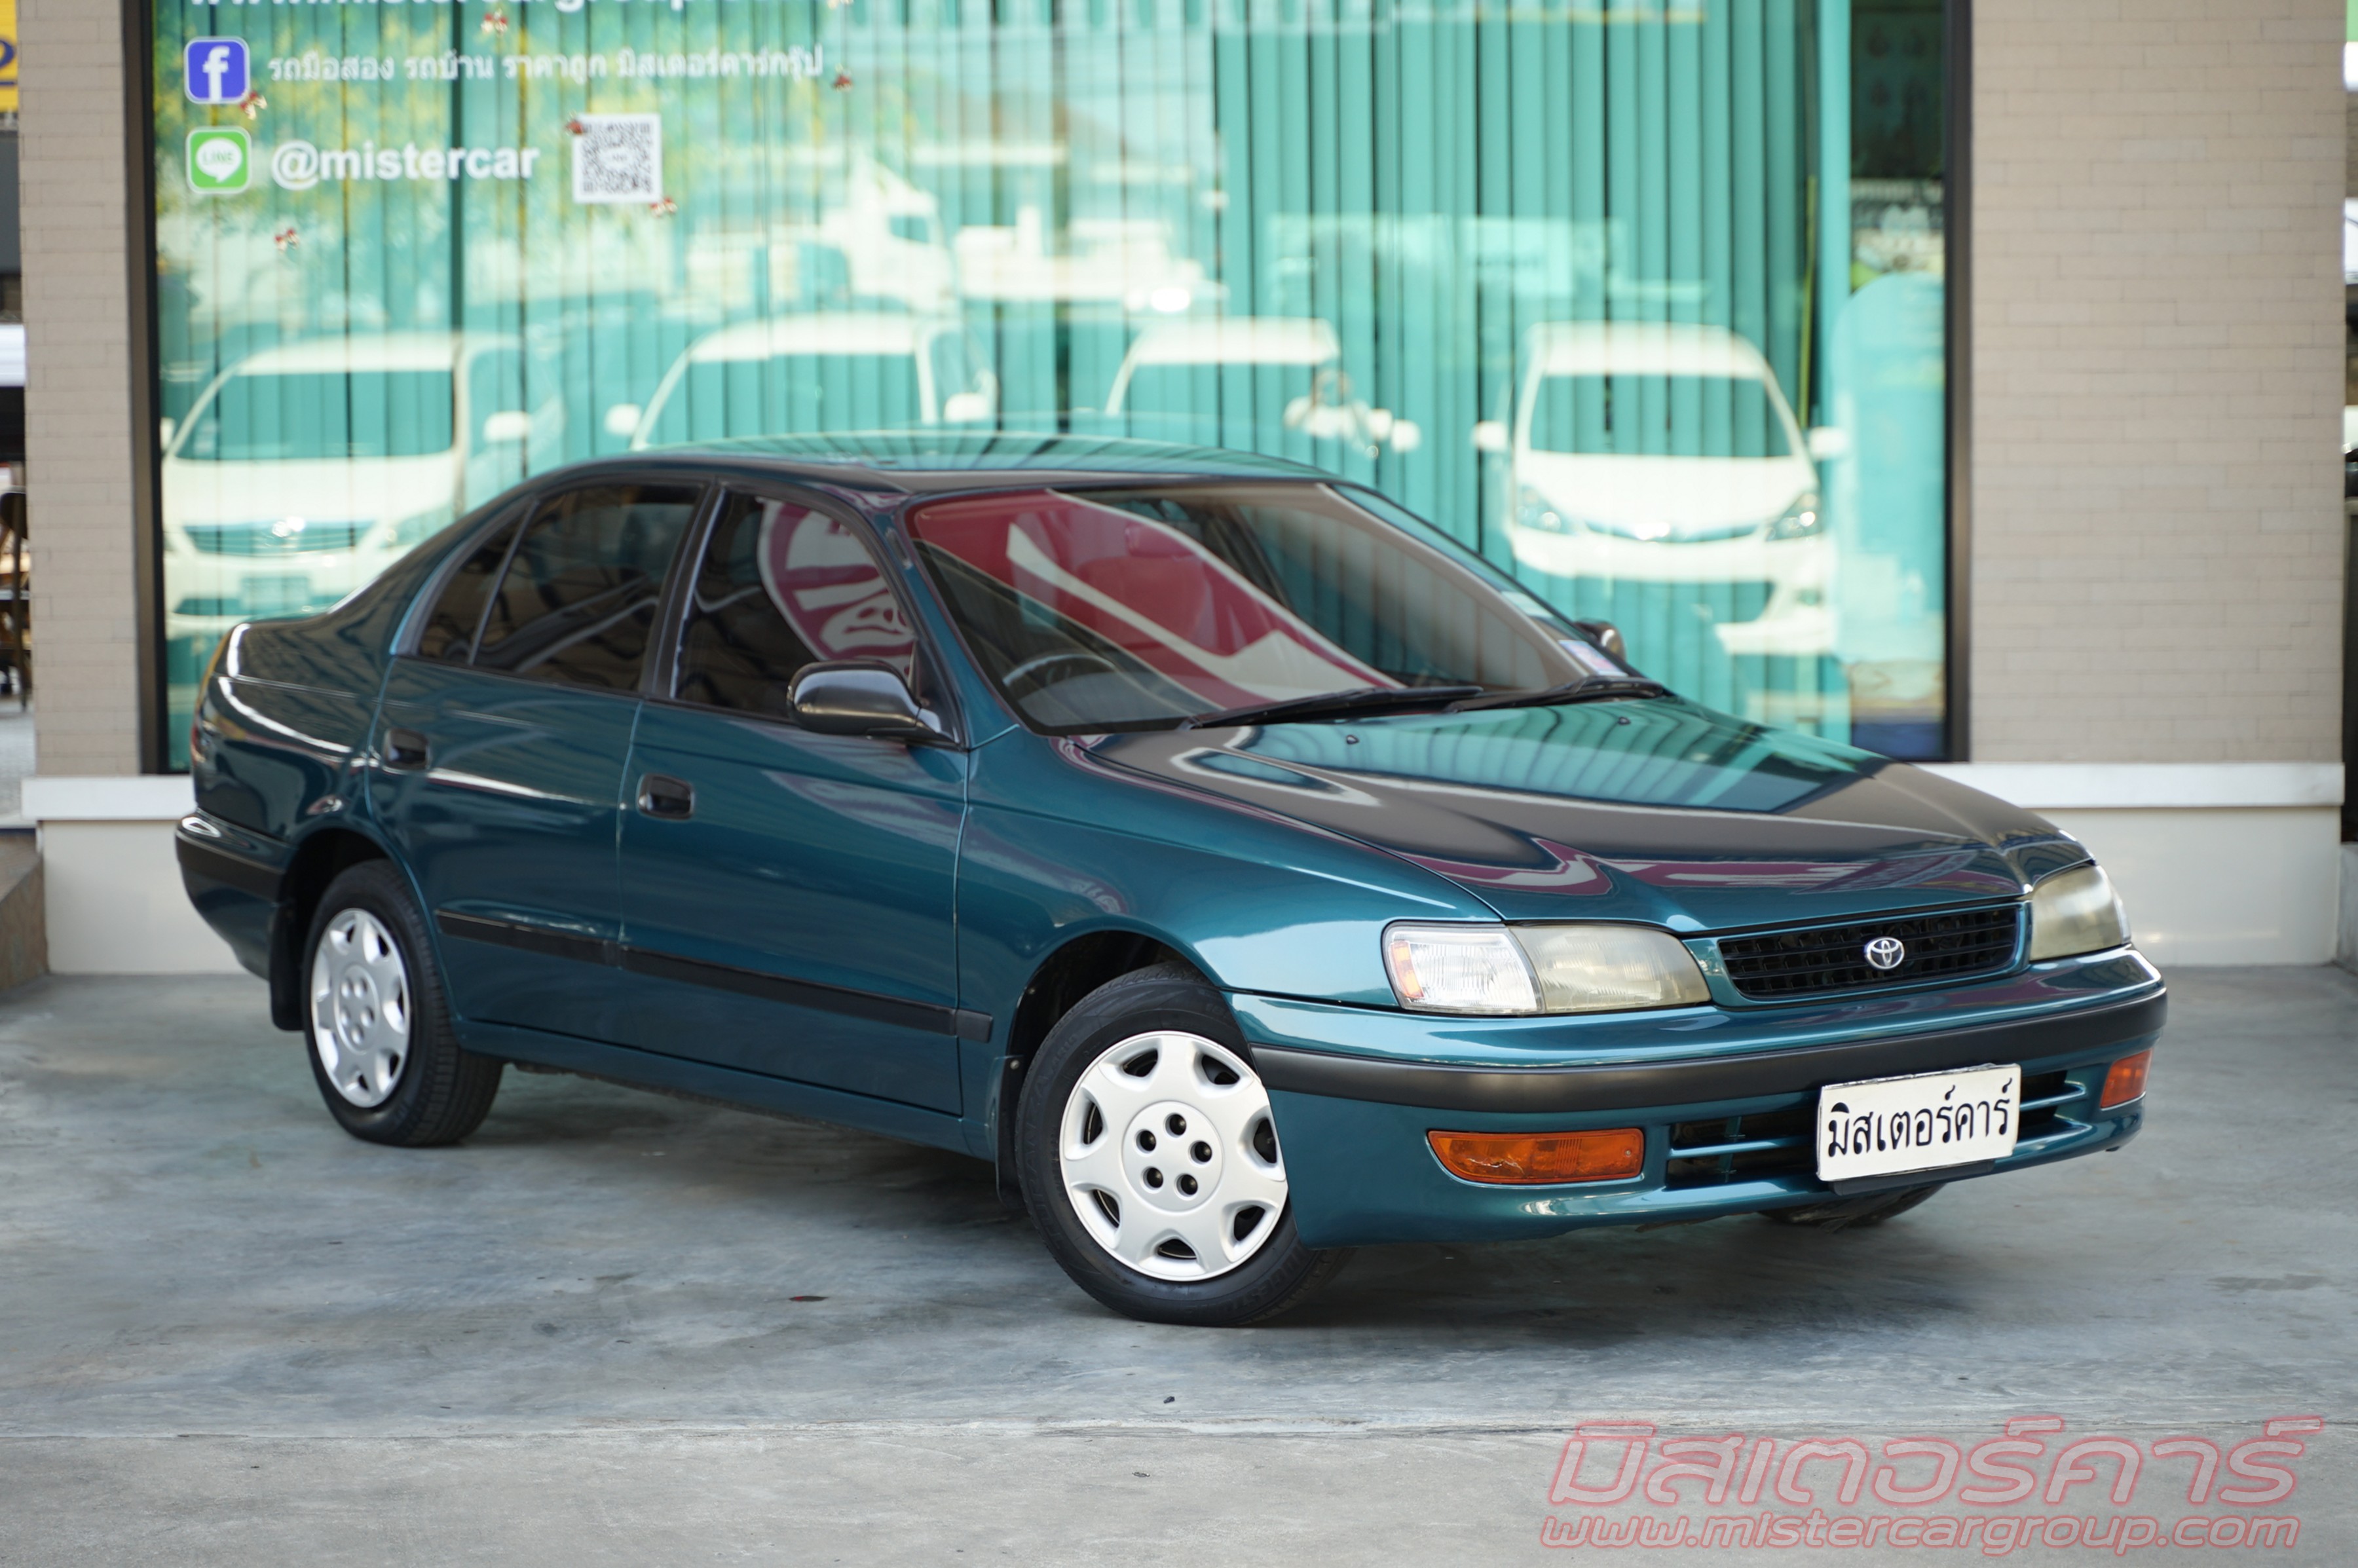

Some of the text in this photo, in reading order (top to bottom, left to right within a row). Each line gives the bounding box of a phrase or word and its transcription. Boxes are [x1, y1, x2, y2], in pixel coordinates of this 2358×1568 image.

[268, 50, 393, 81] รถมือสอง
[403, 49, 495, 79] รถบ้าน
[502, 53, 607, 84] ราคาถูก
[271, 140, 540, 191] @mistercar
[1827, 1077, 2013, 1157] มิสเตอร์คาร์
